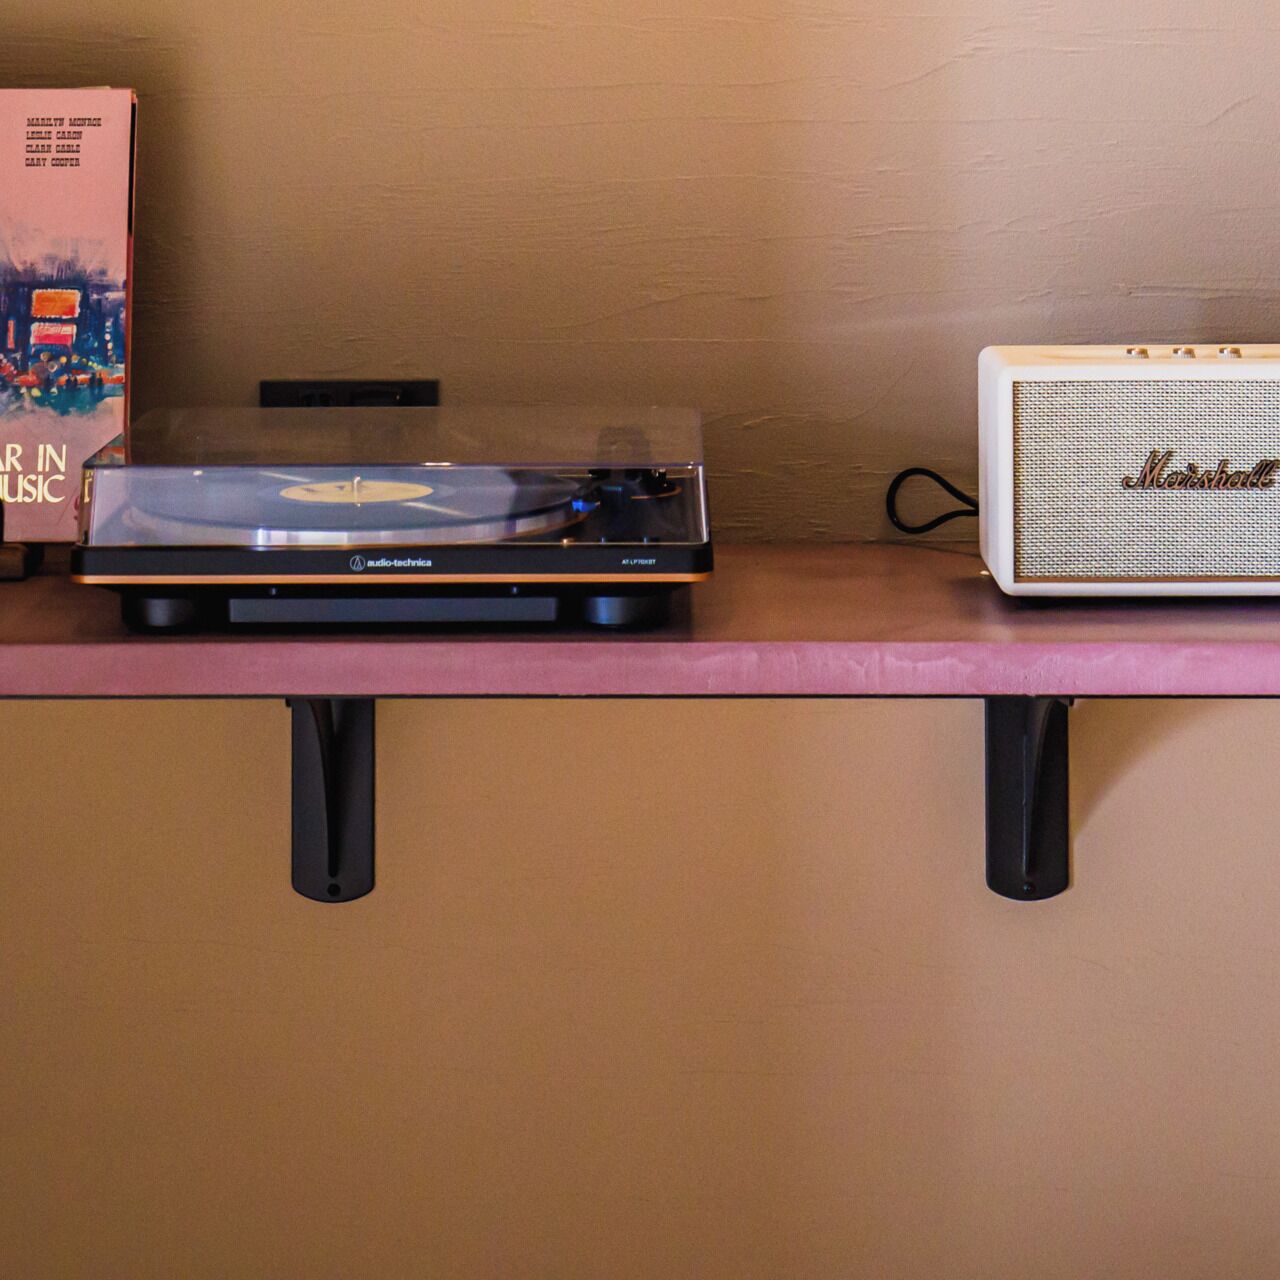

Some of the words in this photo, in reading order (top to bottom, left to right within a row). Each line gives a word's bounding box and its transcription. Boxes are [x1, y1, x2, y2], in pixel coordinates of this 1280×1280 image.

[26, 117, 65, 127] MARILYN
[68, 117, 102, 127] MONROE
[26, 130, 52, 140] LESLIE
[56, 130, 83, 140] CARON
[25, 144, 52, 153] CLARK
[55, 144, 81, 153] GABLE
[25, 157, 48, 167] GARY
[50, 157, 81, 167] COOPER
[37, 443, 67, 473] IN
[366, 557, 432, 568] audio-technica
